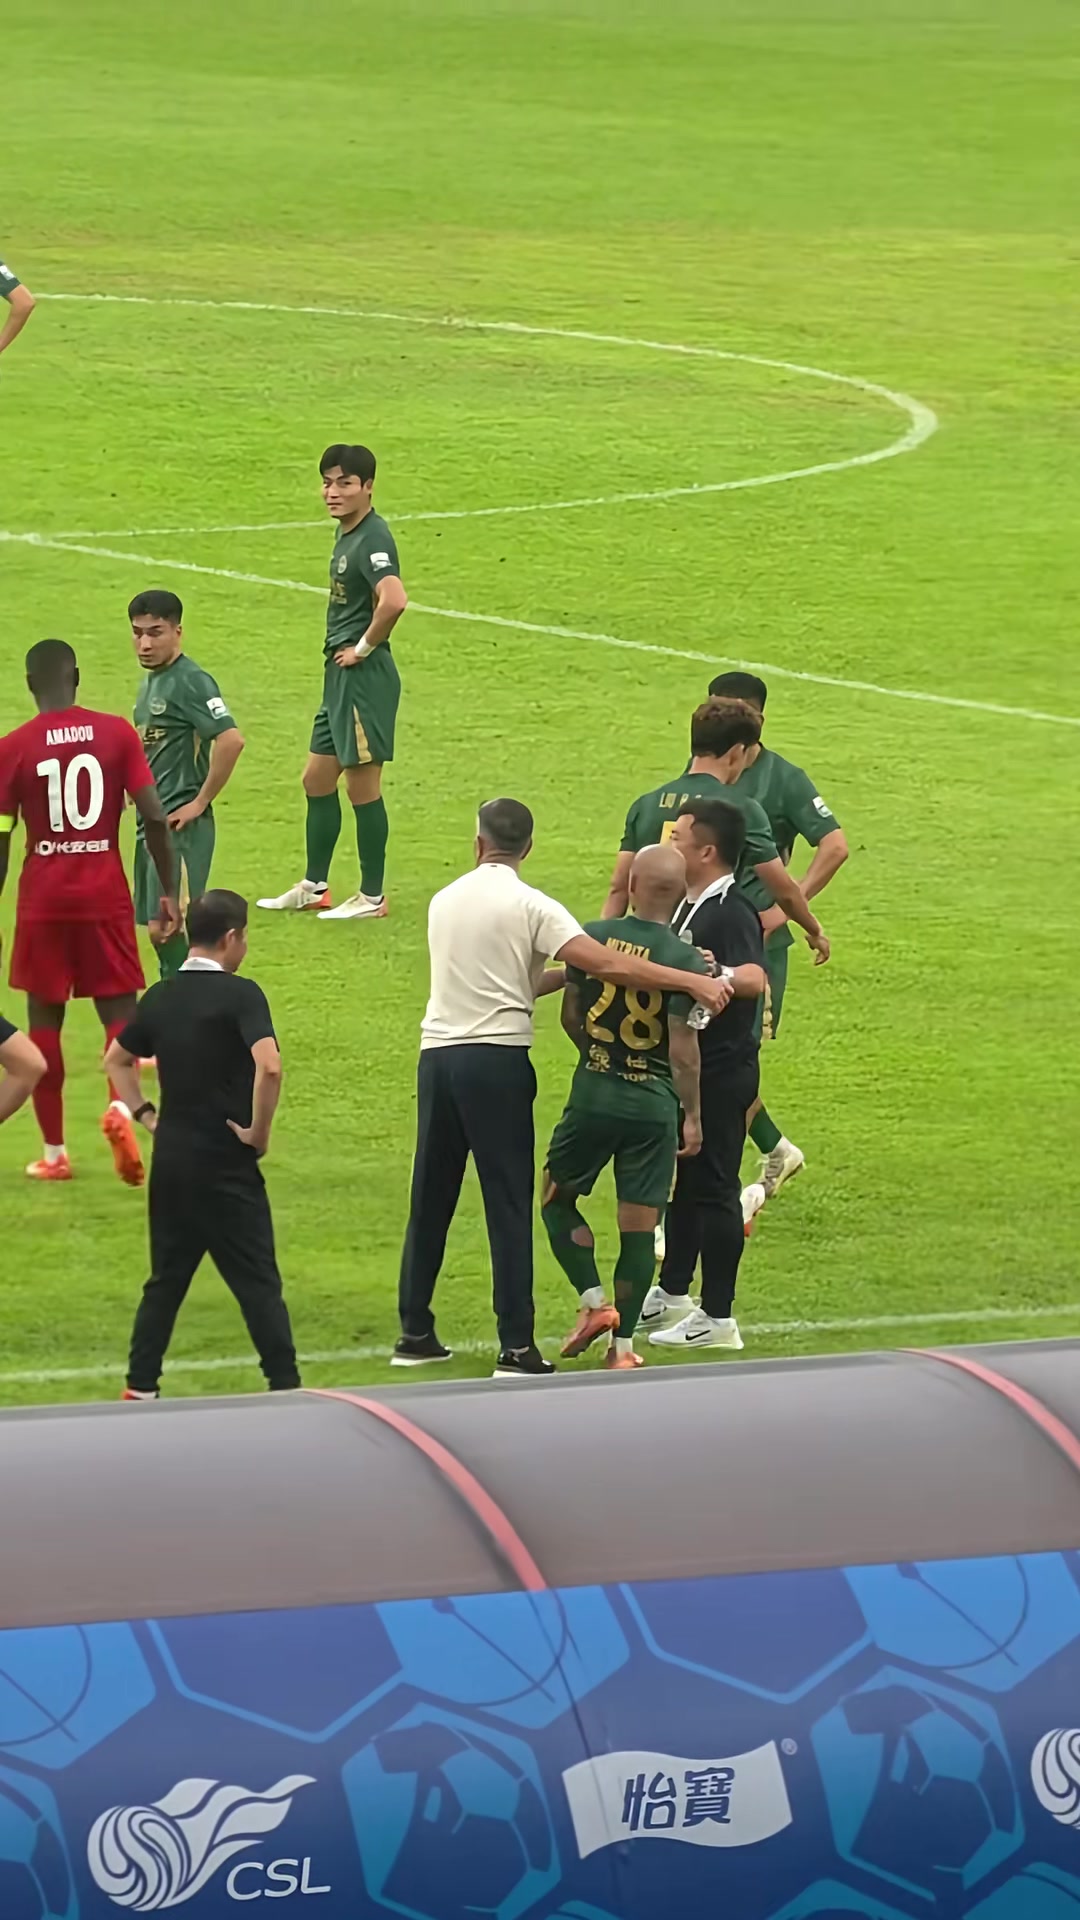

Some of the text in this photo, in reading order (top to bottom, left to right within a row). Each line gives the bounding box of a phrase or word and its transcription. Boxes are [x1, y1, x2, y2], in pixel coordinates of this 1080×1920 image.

[46, 725, 94, 745] AMADOU
[36, 753, 104, 832] 10
[586, 974, 663, 1050] 28
[622, 1767, 735, 1831] 怡寶
[226, 1856, 331, 1901] CSL
